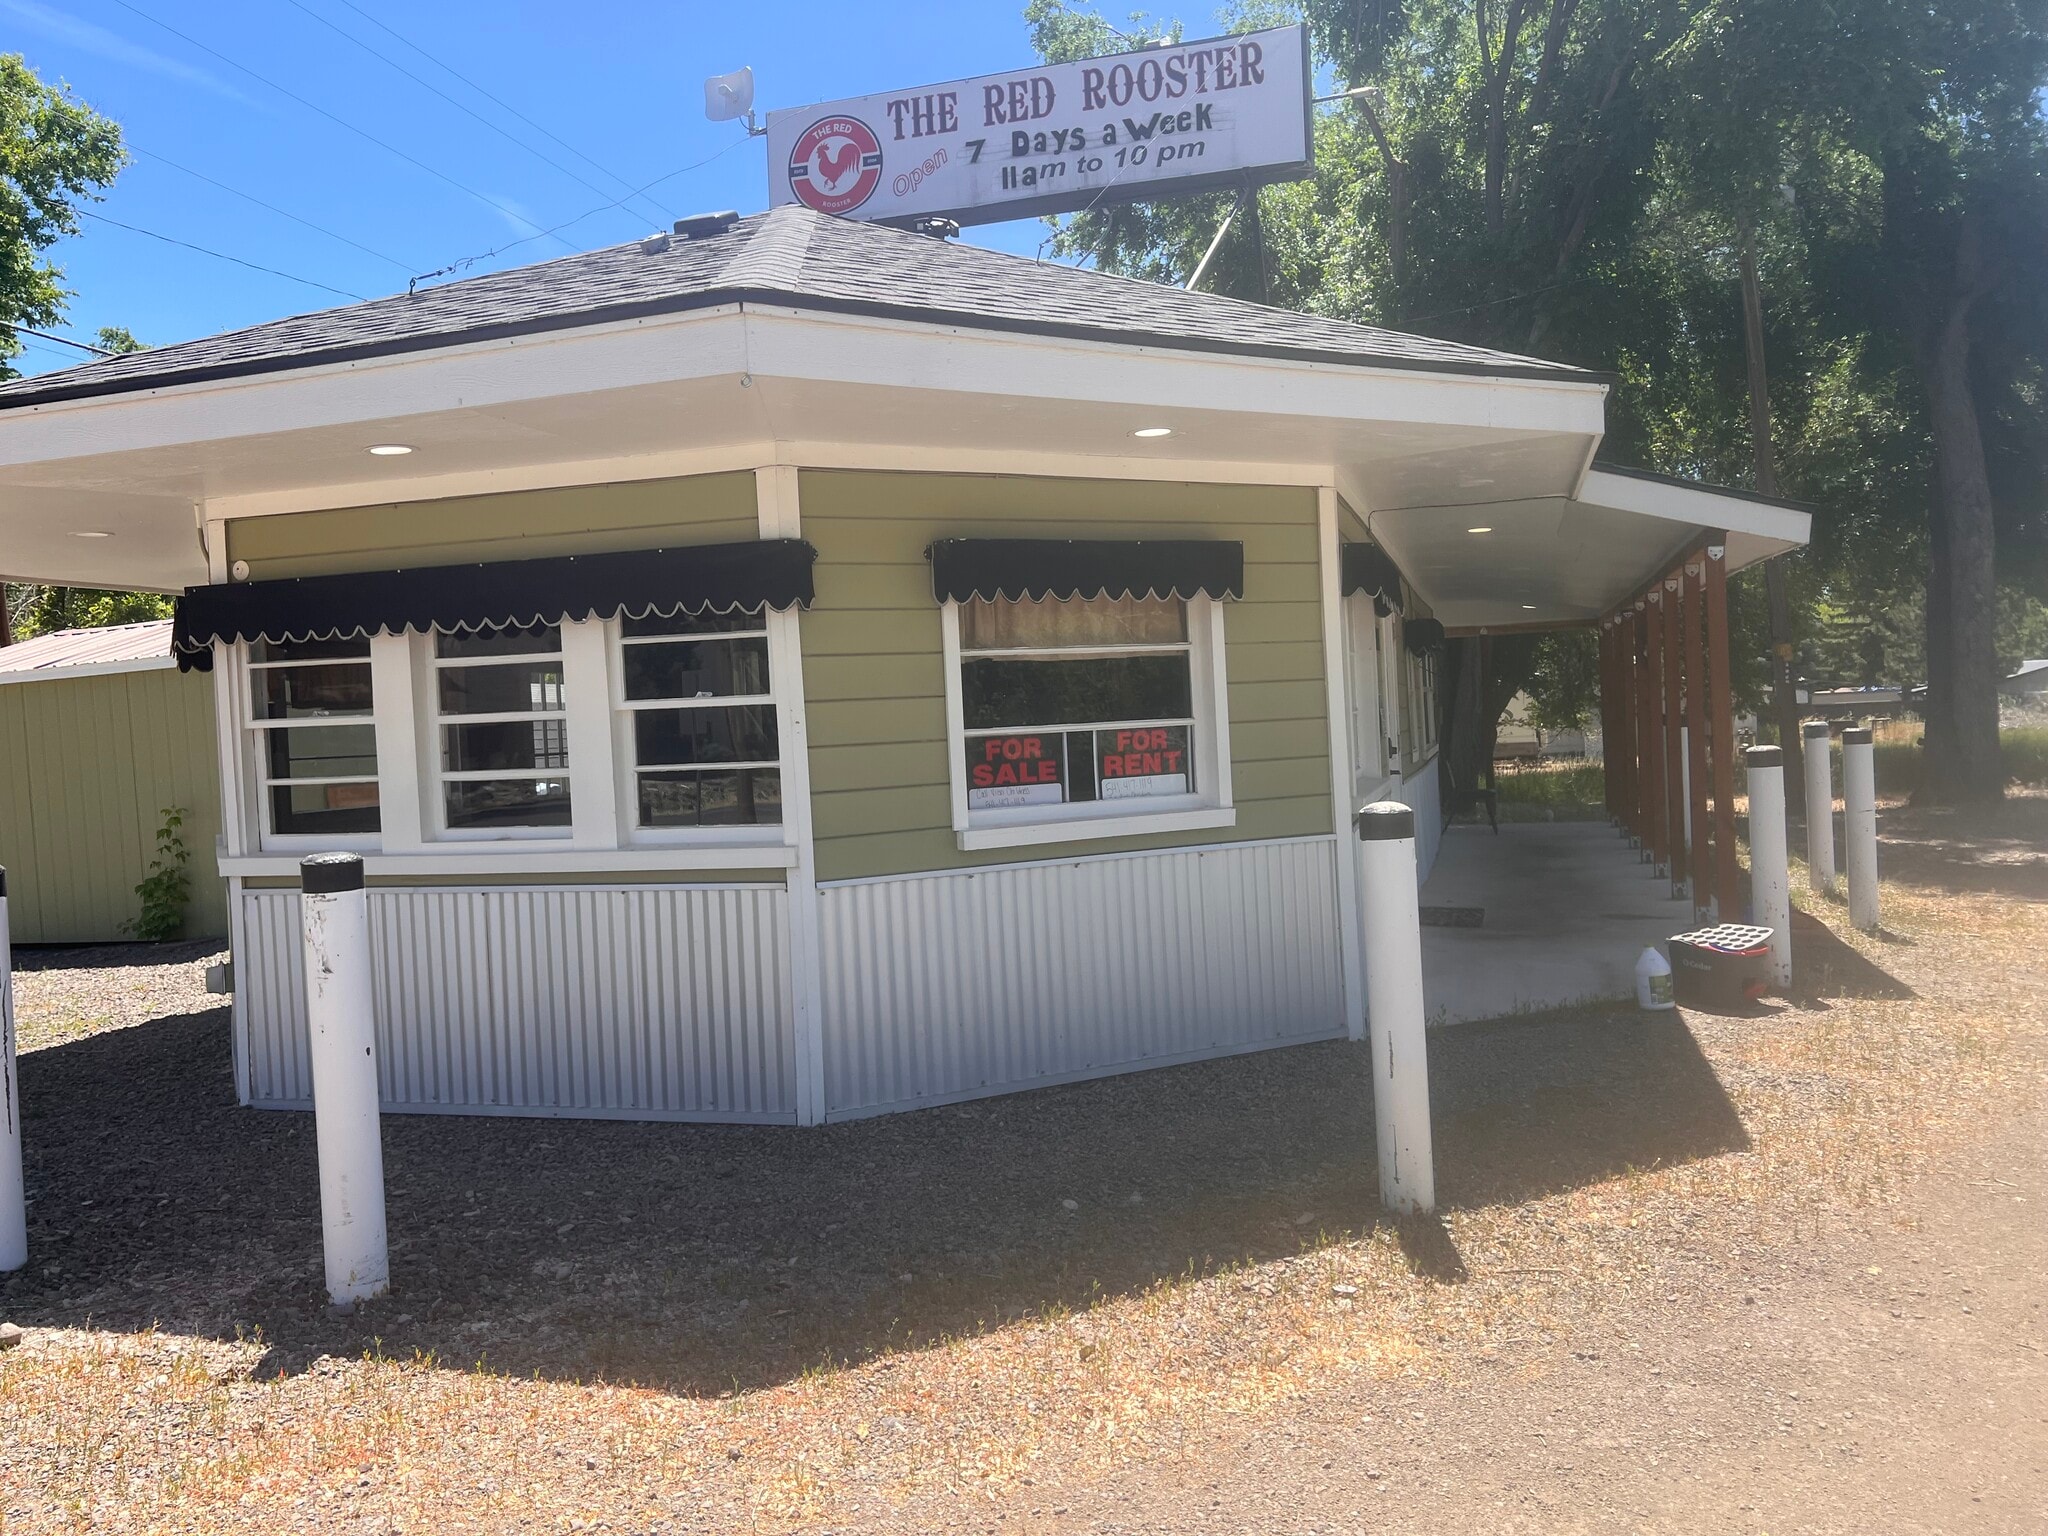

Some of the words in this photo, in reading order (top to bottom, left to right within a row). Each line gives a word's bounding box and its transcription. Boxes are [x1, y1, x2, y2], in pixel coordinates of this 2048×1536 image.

[887, 91, 958, 140] THE
[982, 76, 1056, 127] RED
[1081, 41, 1265, 111] ROOSTER
[812, 124, 832, 140] THE
[833, 123, 852, 134] RED
[965, 138, 986, 163] 7
[1011, 127, 1086, 157] Days
[1102, 122, 1117, 145] a
[893, 148, 948, 197] Open
[1002, 161, 1066, 190] 11am
[1077, 156, 1103, 173] to
[1114, 144, 1148, 168] 10
[1156, 141, 1205, 167] pm
[822, 198, 851, 208] ROOSTER
[985, 737, 1041, 761] FOR
[1117, 728, 1168, 752] FOR
[973, 760, 1057, 787] SALE
[1104, 750, 1182, 777] RENT
